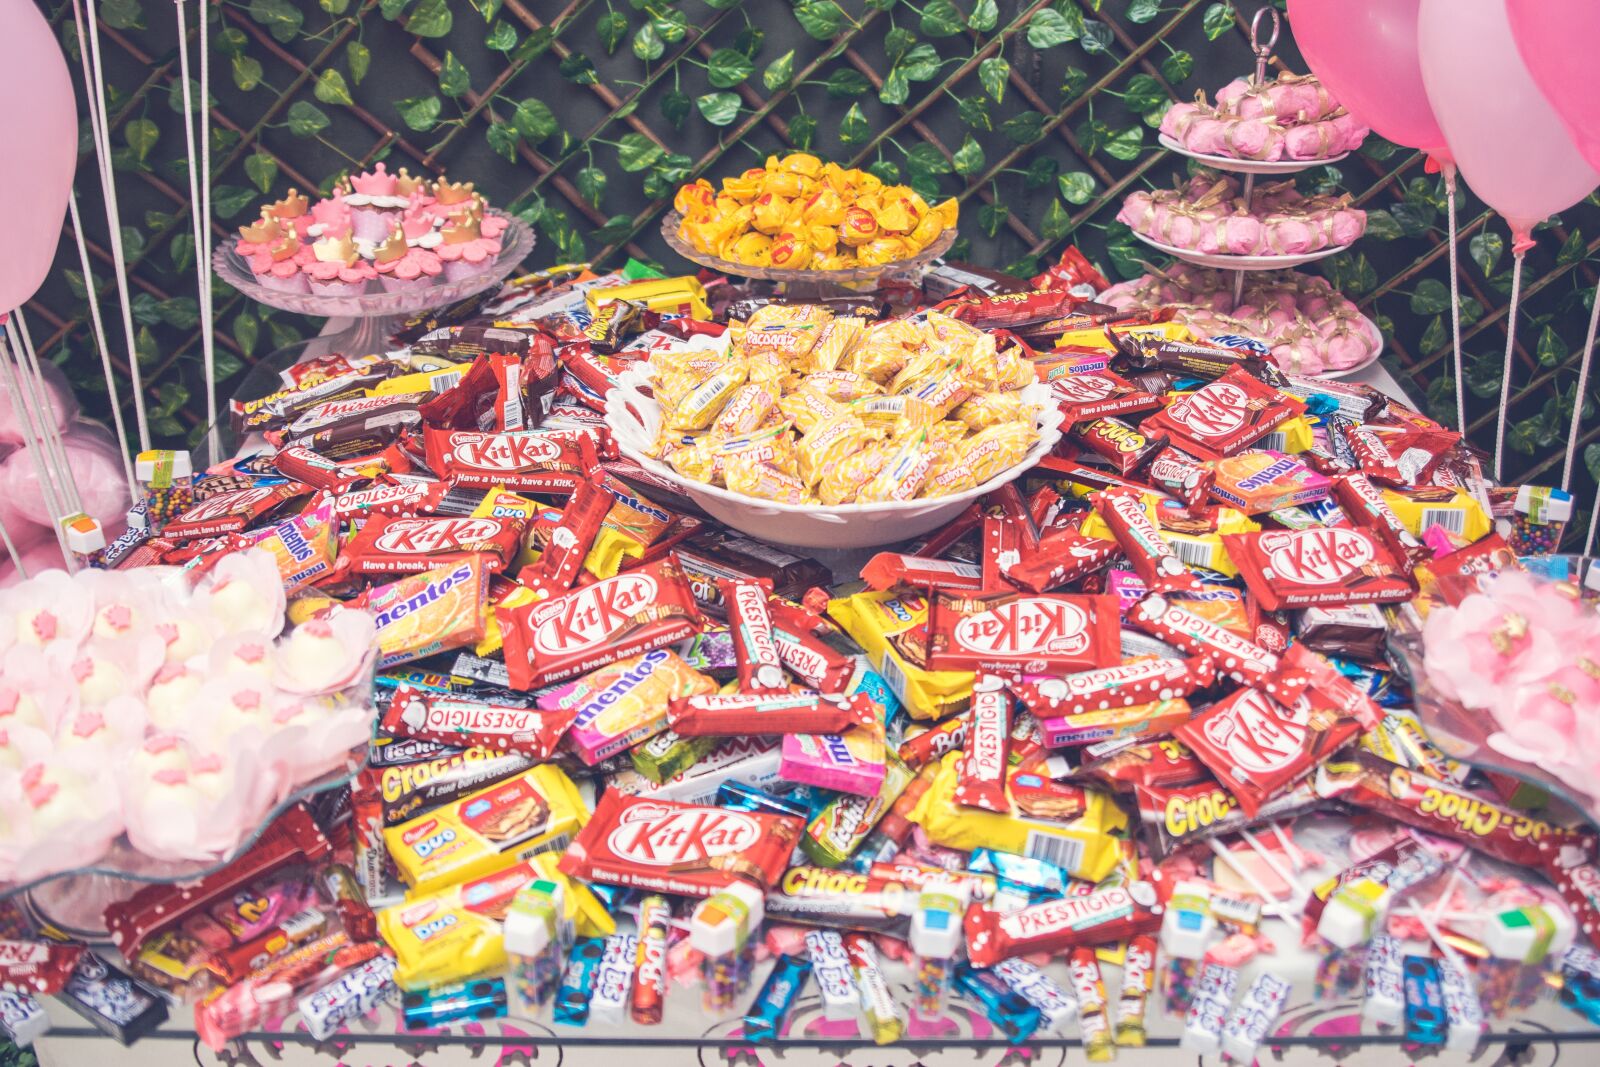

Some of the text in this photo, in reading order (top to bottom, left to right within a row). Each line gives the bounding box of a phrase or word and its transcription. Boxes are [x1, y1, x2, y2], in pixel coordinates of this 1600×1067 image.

[1069, 362, 1104, 373] mentos
[1190, 387, 1241, 433] KitKat
[470, 436, 552, 467] KitKat
[457, 474, 480, 482] Have
[553, 479, 575, 487] KitK
[1239, 459, 1296, 490] mentos
[339, 485, 418, 507] PRESTIGIO
[278, 523, 313, 561] mentos
[390, 521, 489, 550] KitKat
[1119, 500, 1170, 556] PRESTIGIO
[363, 561, 386, 570] Have
[397, 561, 426, 571] break,
[1284, 532, 1364, 579] KitKat
[553, 581, 646, 648] KitKat
[1287, 595, 1308, 603] Have
[1349, 592, 1370, 600] have
[739, 591, 774, 662] PRESTIGIO
[968, 603, 1066, 651] KitKat
[1168, 610, 1266, 660] PRESTIGIO
[544, 669, 570, 682] Have
[582, 654, 615, 670] break,
[617, 646, 641, 659] have
[574, 649, 667, 726] mentos
[431, 710, 528, 728] PRESTIGIO
[980, 695, 997, 770] PRESTIGIO
[1054, 728, 1115, 744] mentos
[626, 813, 745, 859] KitKat
[592, 869, 619, 881] Have
[622, 874, 630, 882] a
[669, 881, 698, 894] have
[1019, 892, 1126, 932] PRESTIGIO
